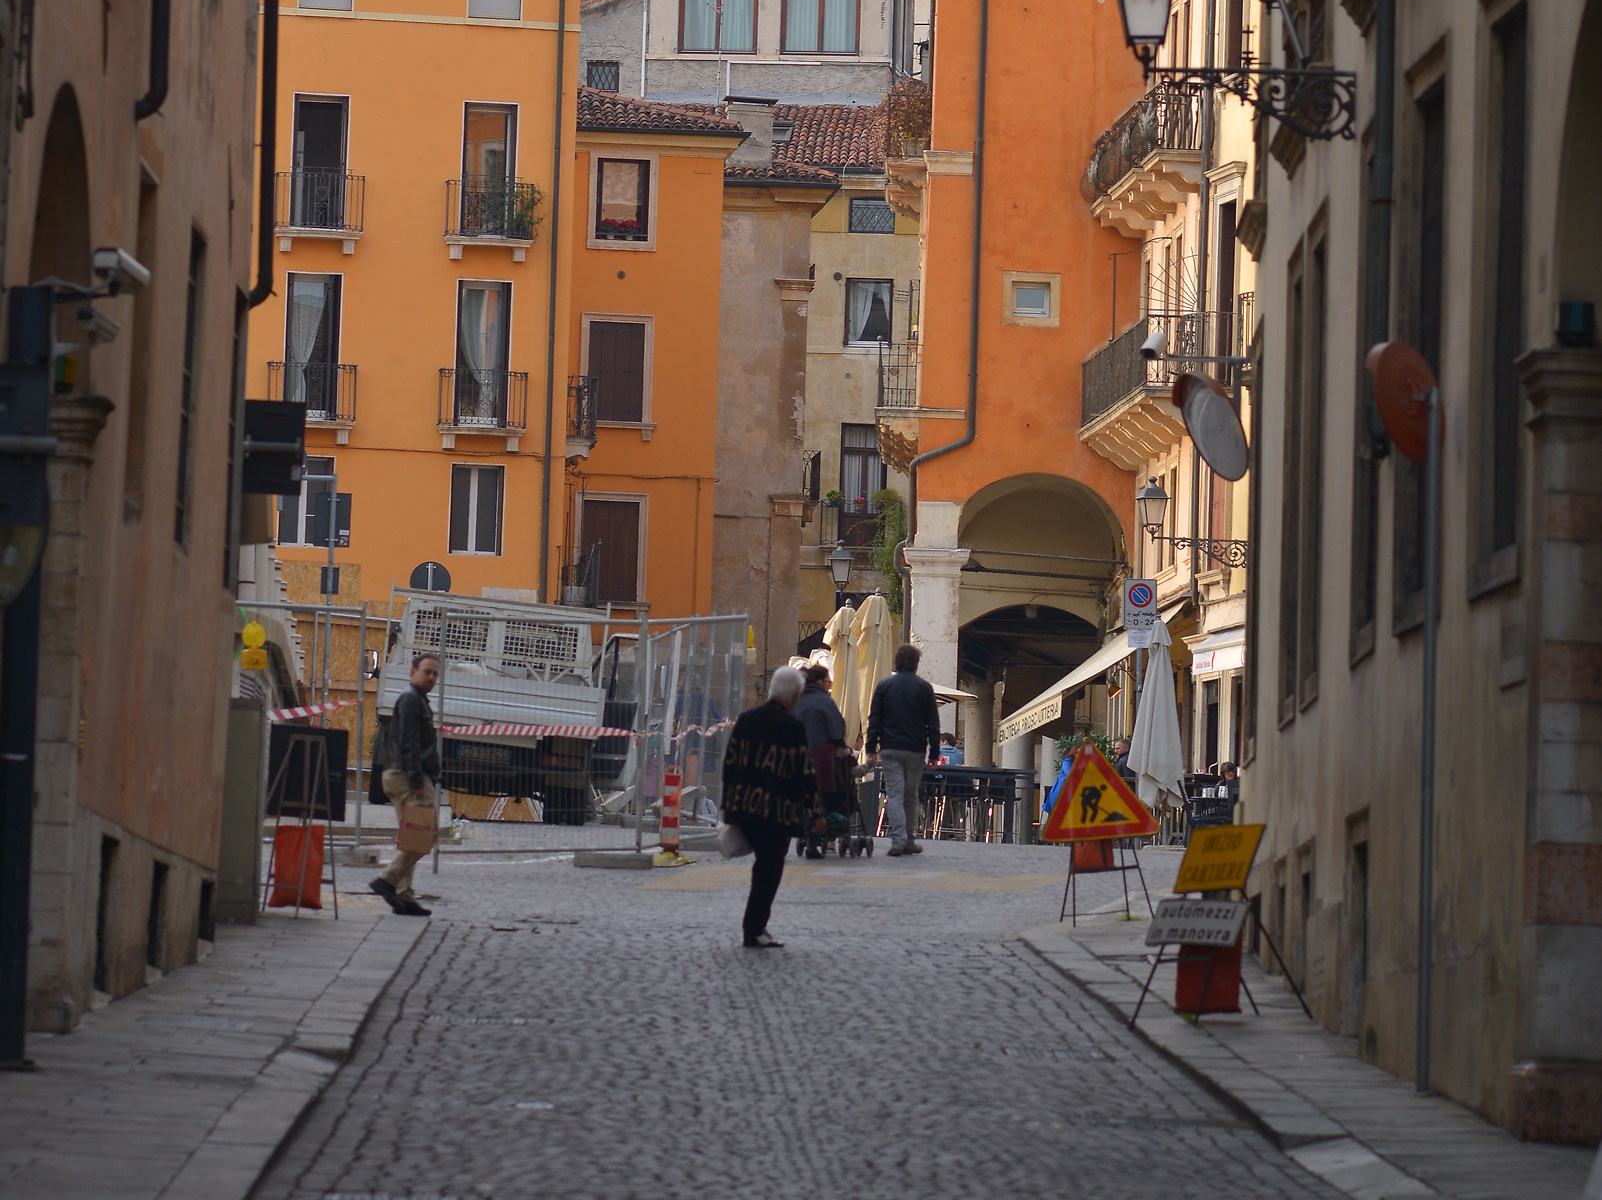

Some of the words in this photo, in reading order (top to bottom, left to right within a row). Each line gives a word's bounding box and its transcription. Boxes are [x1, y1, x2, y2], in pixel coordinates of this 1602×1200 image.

[1201, 831, 1243, 854] INIZIO
[1181, 860, 1246, 885] CANTIERE
[1161, 904, 1238, 920] automezzi
[1151, 925, 1163, 939] in
[1166, 927, 1231, 941] manovra
